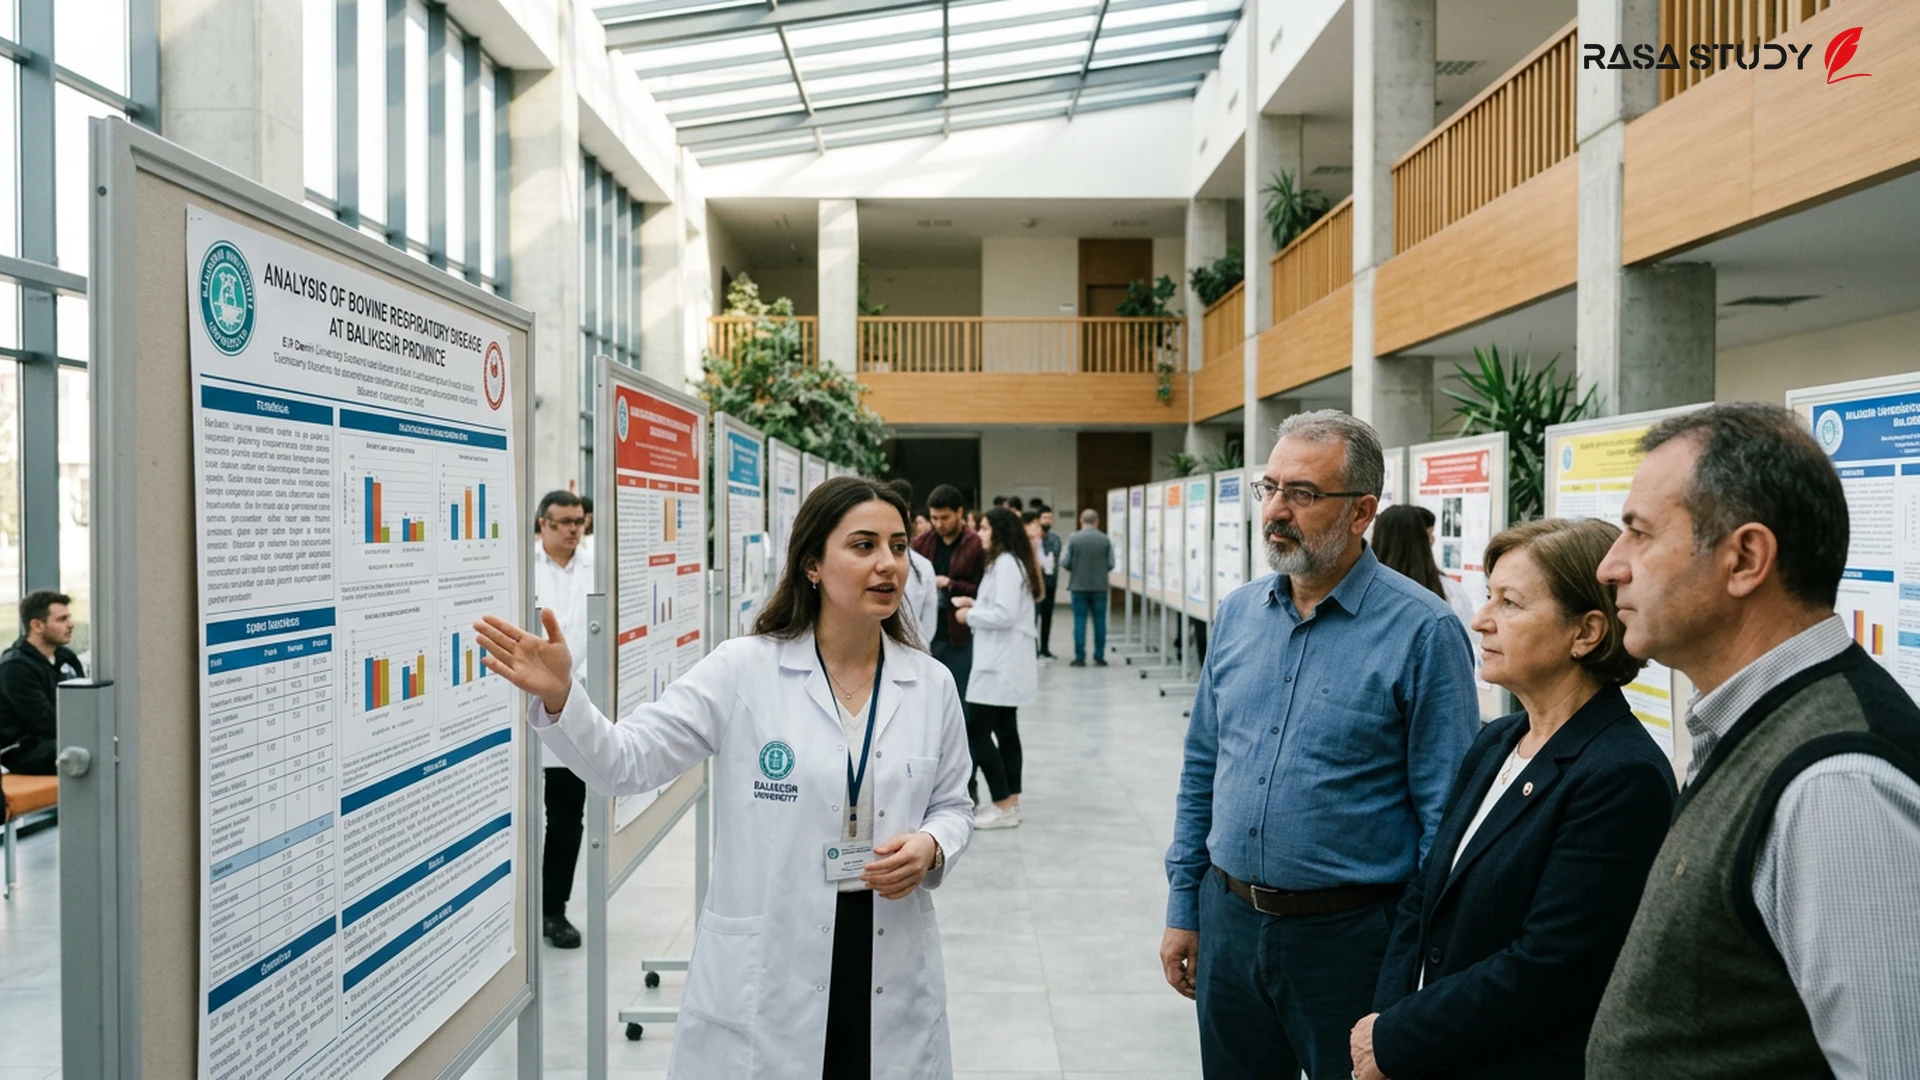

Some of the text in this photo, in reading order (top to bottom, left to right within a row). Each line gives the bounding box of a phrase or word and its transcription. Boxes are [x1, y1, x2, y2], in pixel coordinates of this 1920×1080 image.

[263, 262, 327, 304] ANALYSIS
[329, 285, 346, 308] OF
[349, 291, 388, 322] BOVINE
[329, 317, 345, 339] AT
[347, 321, 401, 355] BALIKESIR
